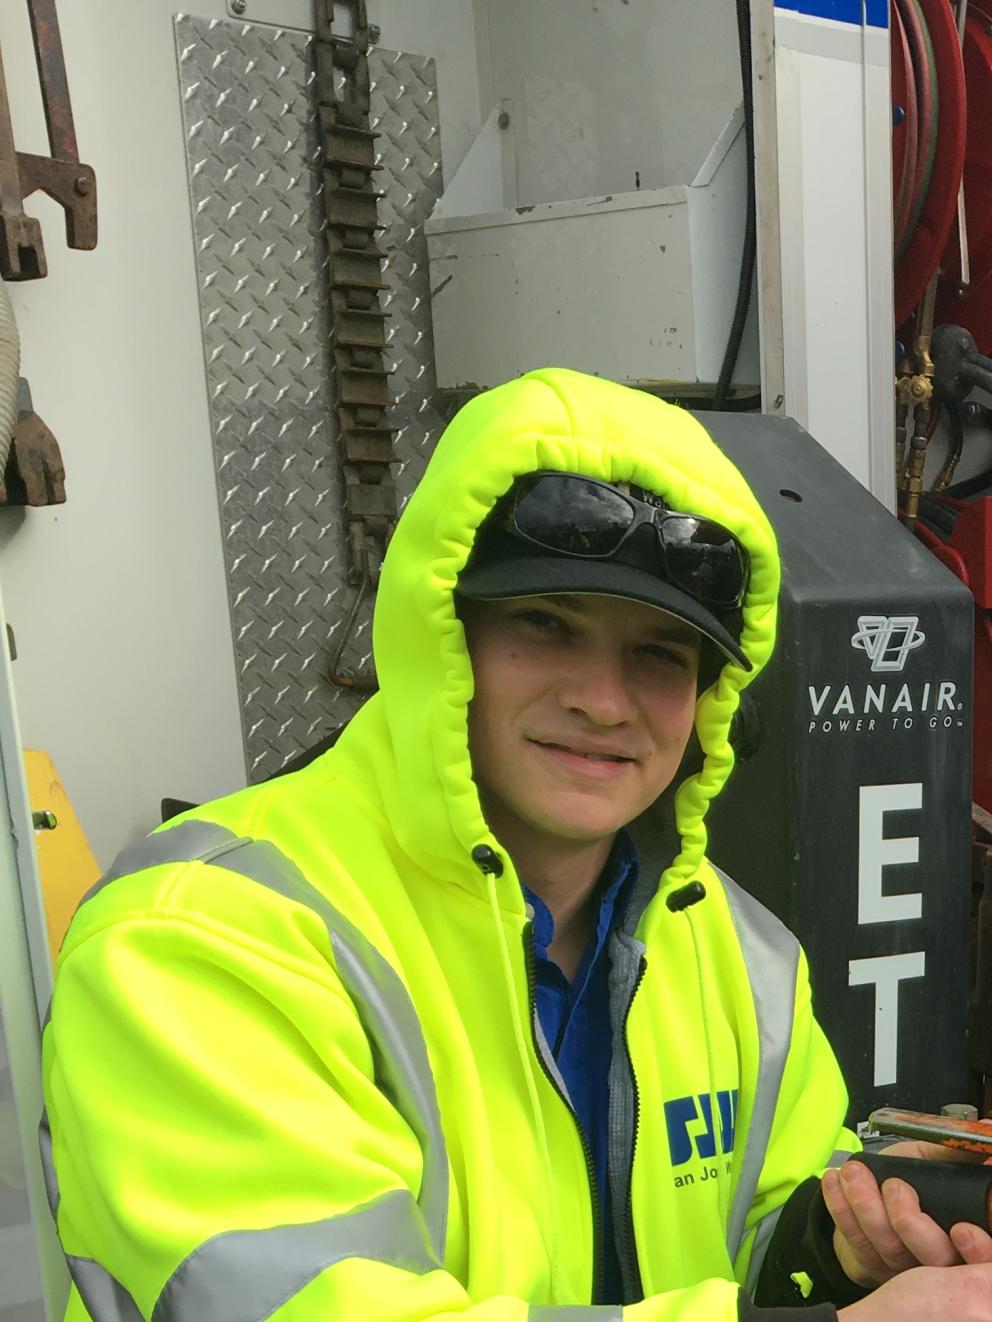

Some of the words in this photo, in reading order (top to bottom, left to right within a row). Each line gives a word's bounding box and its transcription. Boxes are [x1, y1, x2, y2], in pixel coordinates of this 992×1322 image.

[808, 718, 876, 733] POWER
[892, 717, 913, 730] TO
[673, 1171, 695, 1188] an
[700, 1165, 718, 1183] Jo
